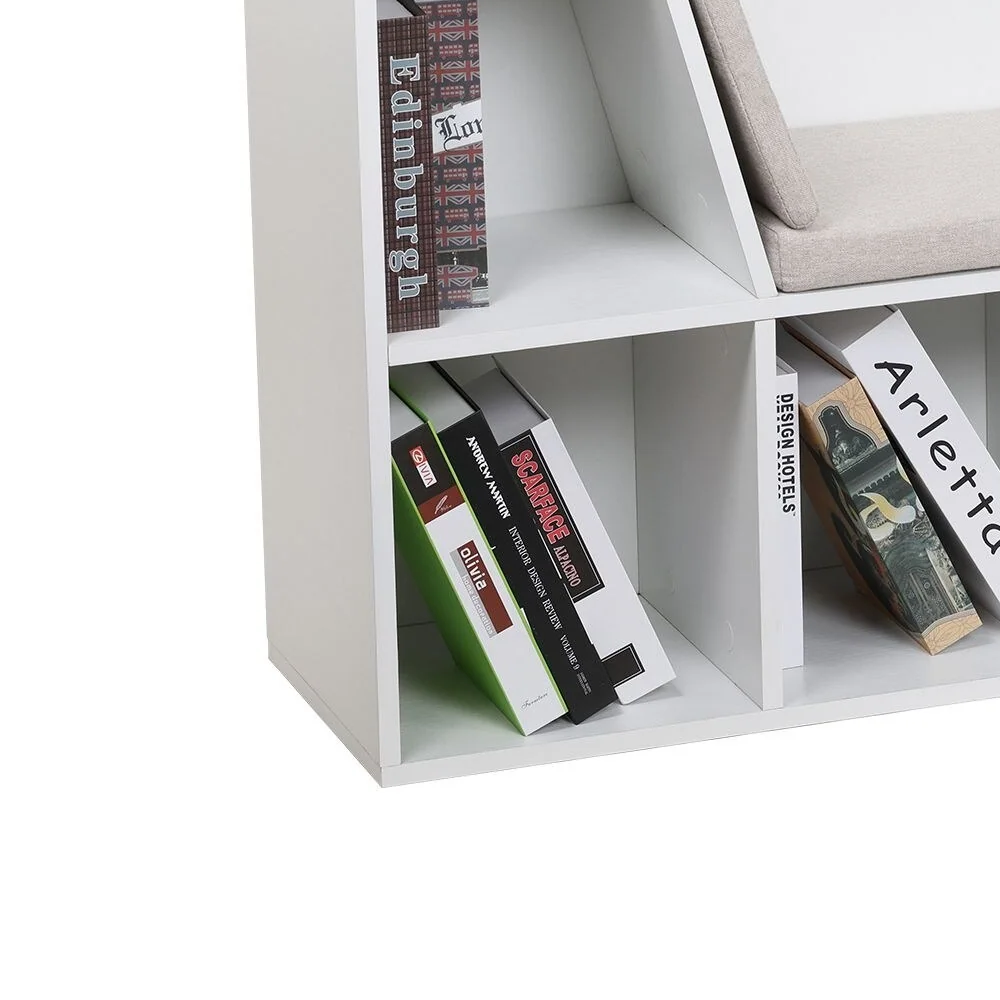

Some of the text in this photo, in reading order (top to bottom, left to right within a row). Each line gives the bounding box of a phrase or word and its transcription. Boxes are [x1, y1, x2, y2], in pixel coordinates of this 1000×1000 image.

[389, 53, 428, 301] Edinburgh
[466, 436, 511, 519] ANDREW MARTIN
[511, 449, 570, 544] SCARFACE
[780, 393, 796, 513] DESIGN HOTELS
[460, 547, 487, 591] olivia
[508, 526, 532, 566] INTERIOR
[527, 566, 548, 599] DESIGN
[542, 599, 563, 631] REVIEW
[560, 634, 578, 666] VOLUME
